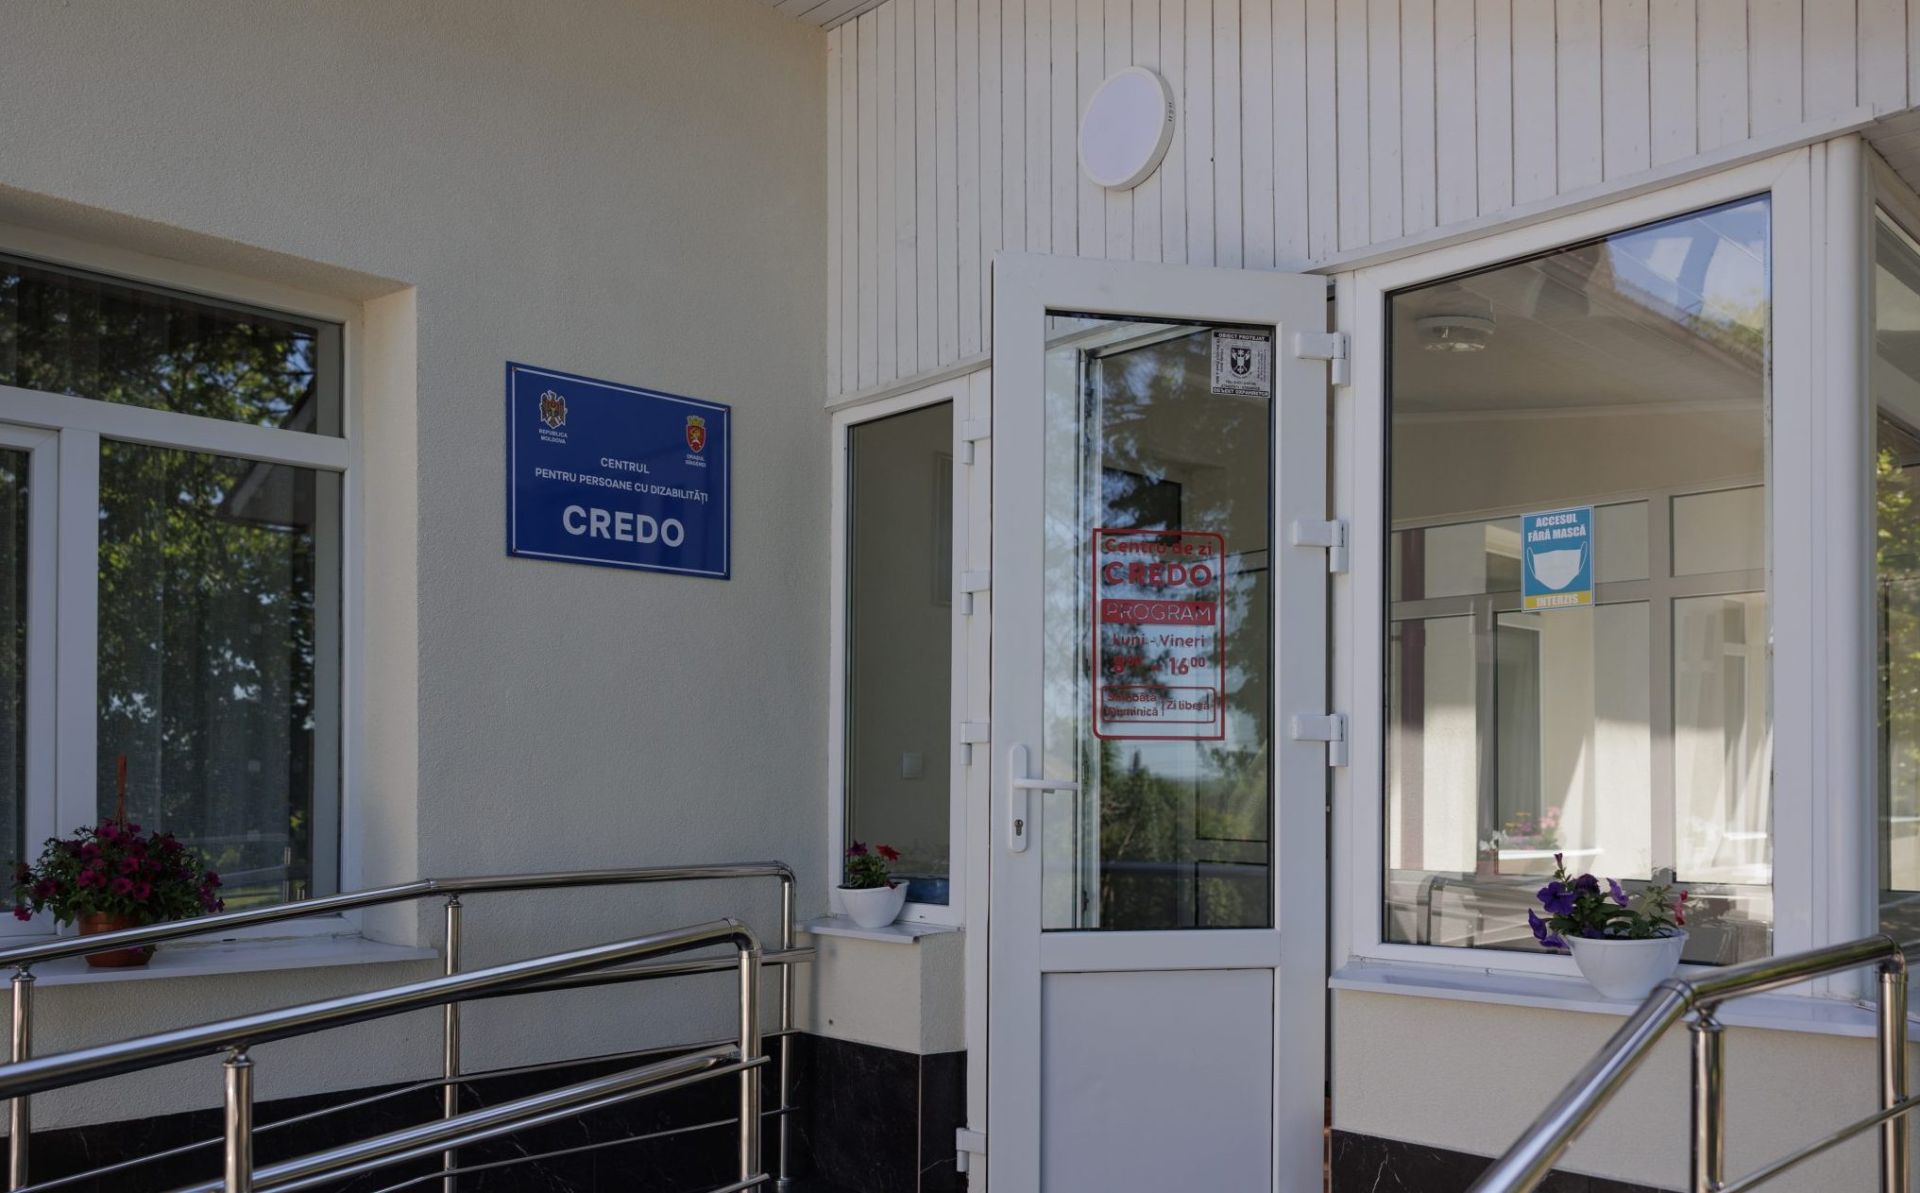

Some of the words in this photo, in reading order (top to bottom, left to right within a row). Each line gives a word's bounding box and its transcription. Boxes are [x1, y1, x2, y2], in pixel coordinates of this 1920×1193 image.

[600, 457, 650, 474] CENTRUL
[535, 467, 577, 482] PENTRU
[579, 474, 633, 491] PERSOANE
[634, 482, 649, 493] CU
[650, 485, 708, 504] DIZABILITĂȚI
[563, 504, 685, 547] CREDO
[1536, 514, 1578, 527] ACCESUL
[1528, 529, 1551, 542] FĂRĂ
[1552, 524, 1586, 539] MASCĂ
[1104, 538, 1166, 554] Centru
[1172, 541, 1193, 555] de
[1198, 541, 1212, 556] zi
[1104, 561, 1212, 588] CREDO
[1536, 594, 1578, 608] INTERZIS
[1106, 602, 1211, 622] PROGRAM
[1112, 633, 1145, 647] Luni
[1160, 634, 1205, 648] Vineri
[1166, 700, 1177, 710] Zi
